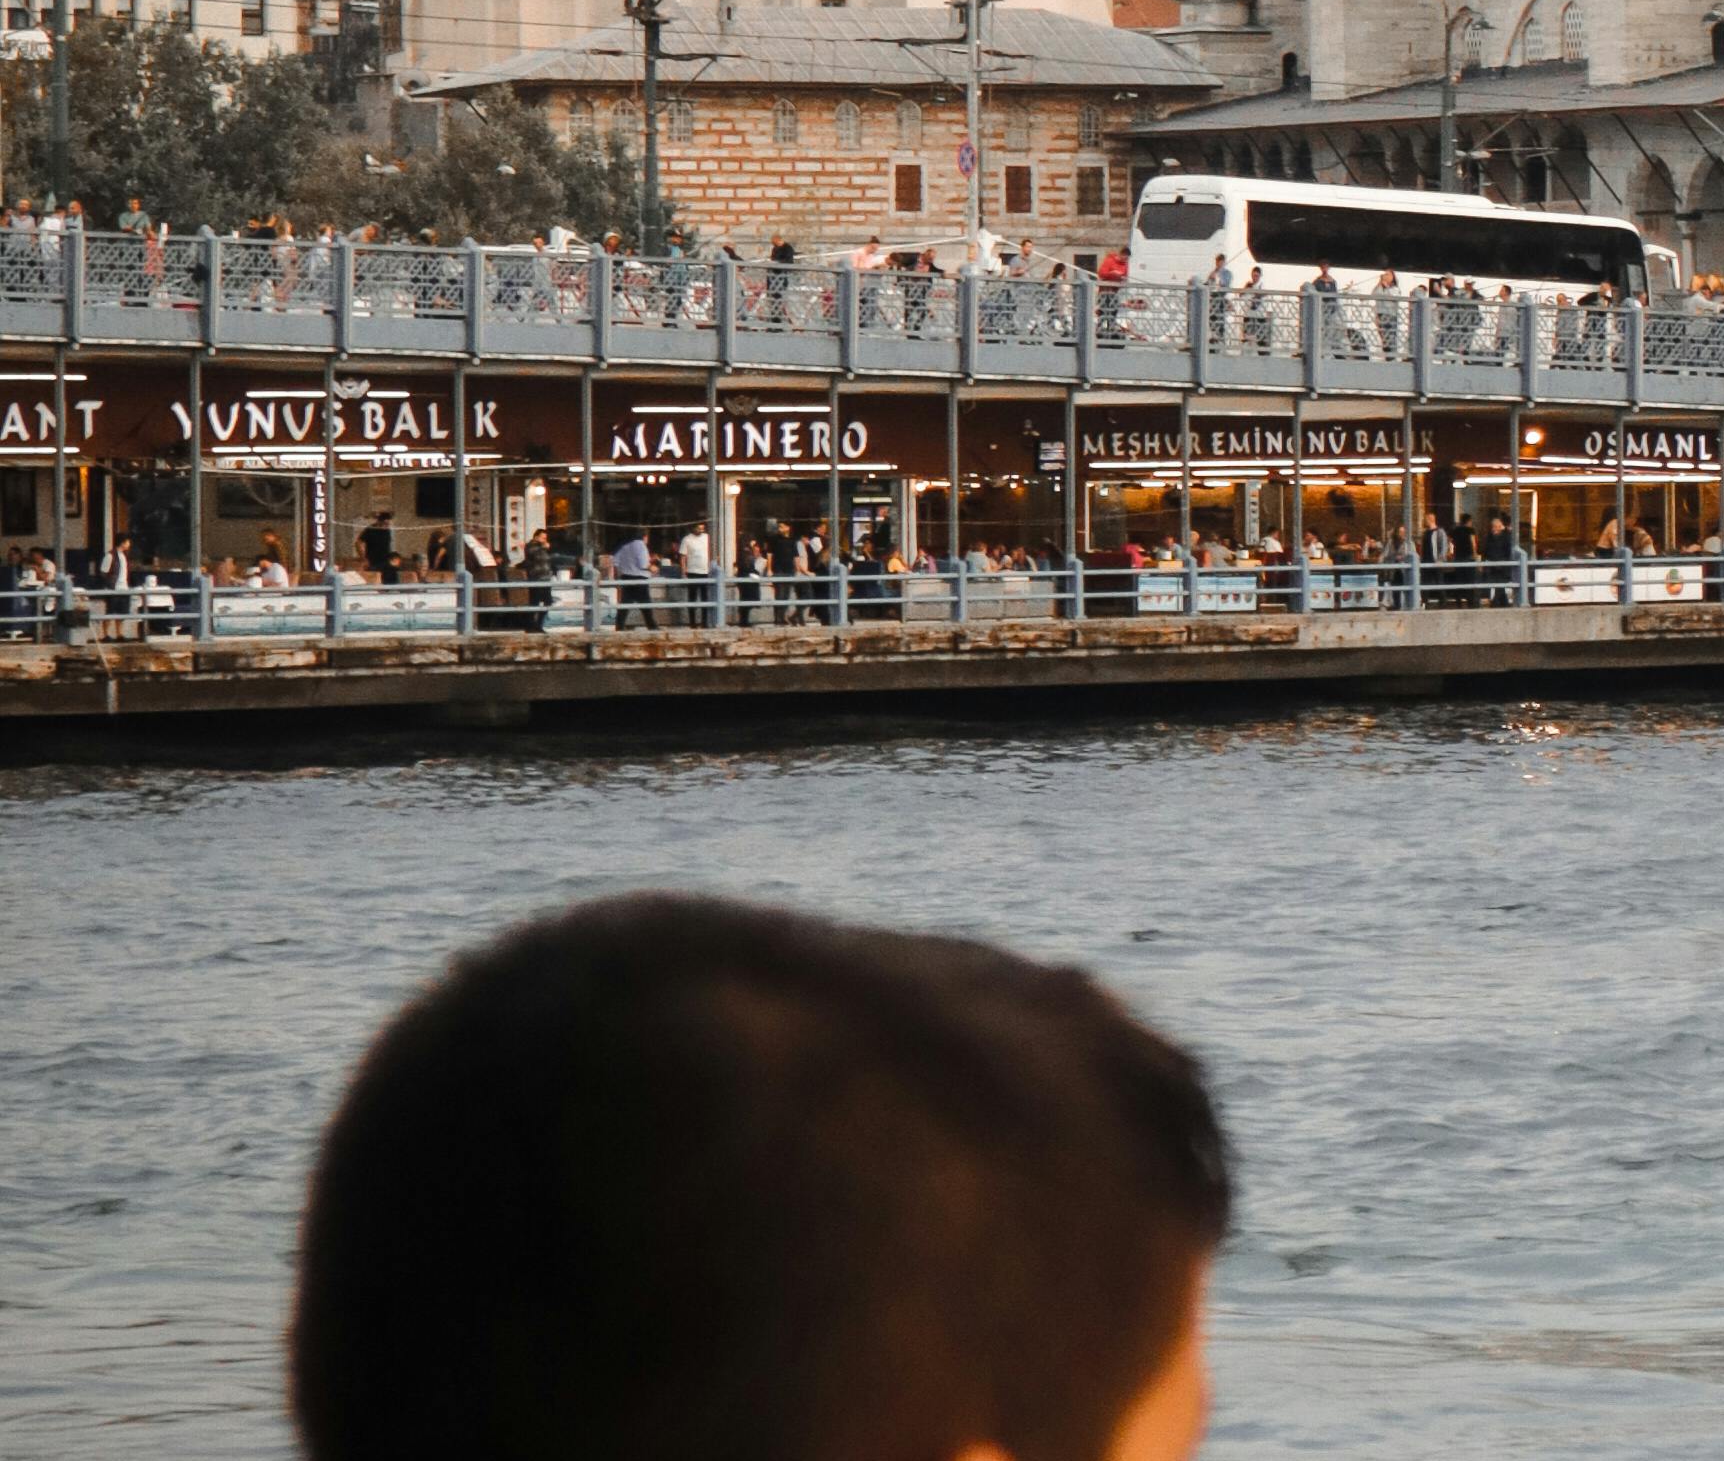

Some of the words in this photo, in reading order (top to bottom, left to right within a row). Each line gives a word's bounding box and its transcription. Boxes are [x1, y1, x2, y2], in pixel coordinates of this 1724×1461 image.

[170, 401, 346, 441] YUNUS
[360, 401, 499, 440] BALK
[612, 421, 868, 459] MARINERO
[1585, 431, 1720, 461] OSMANL
